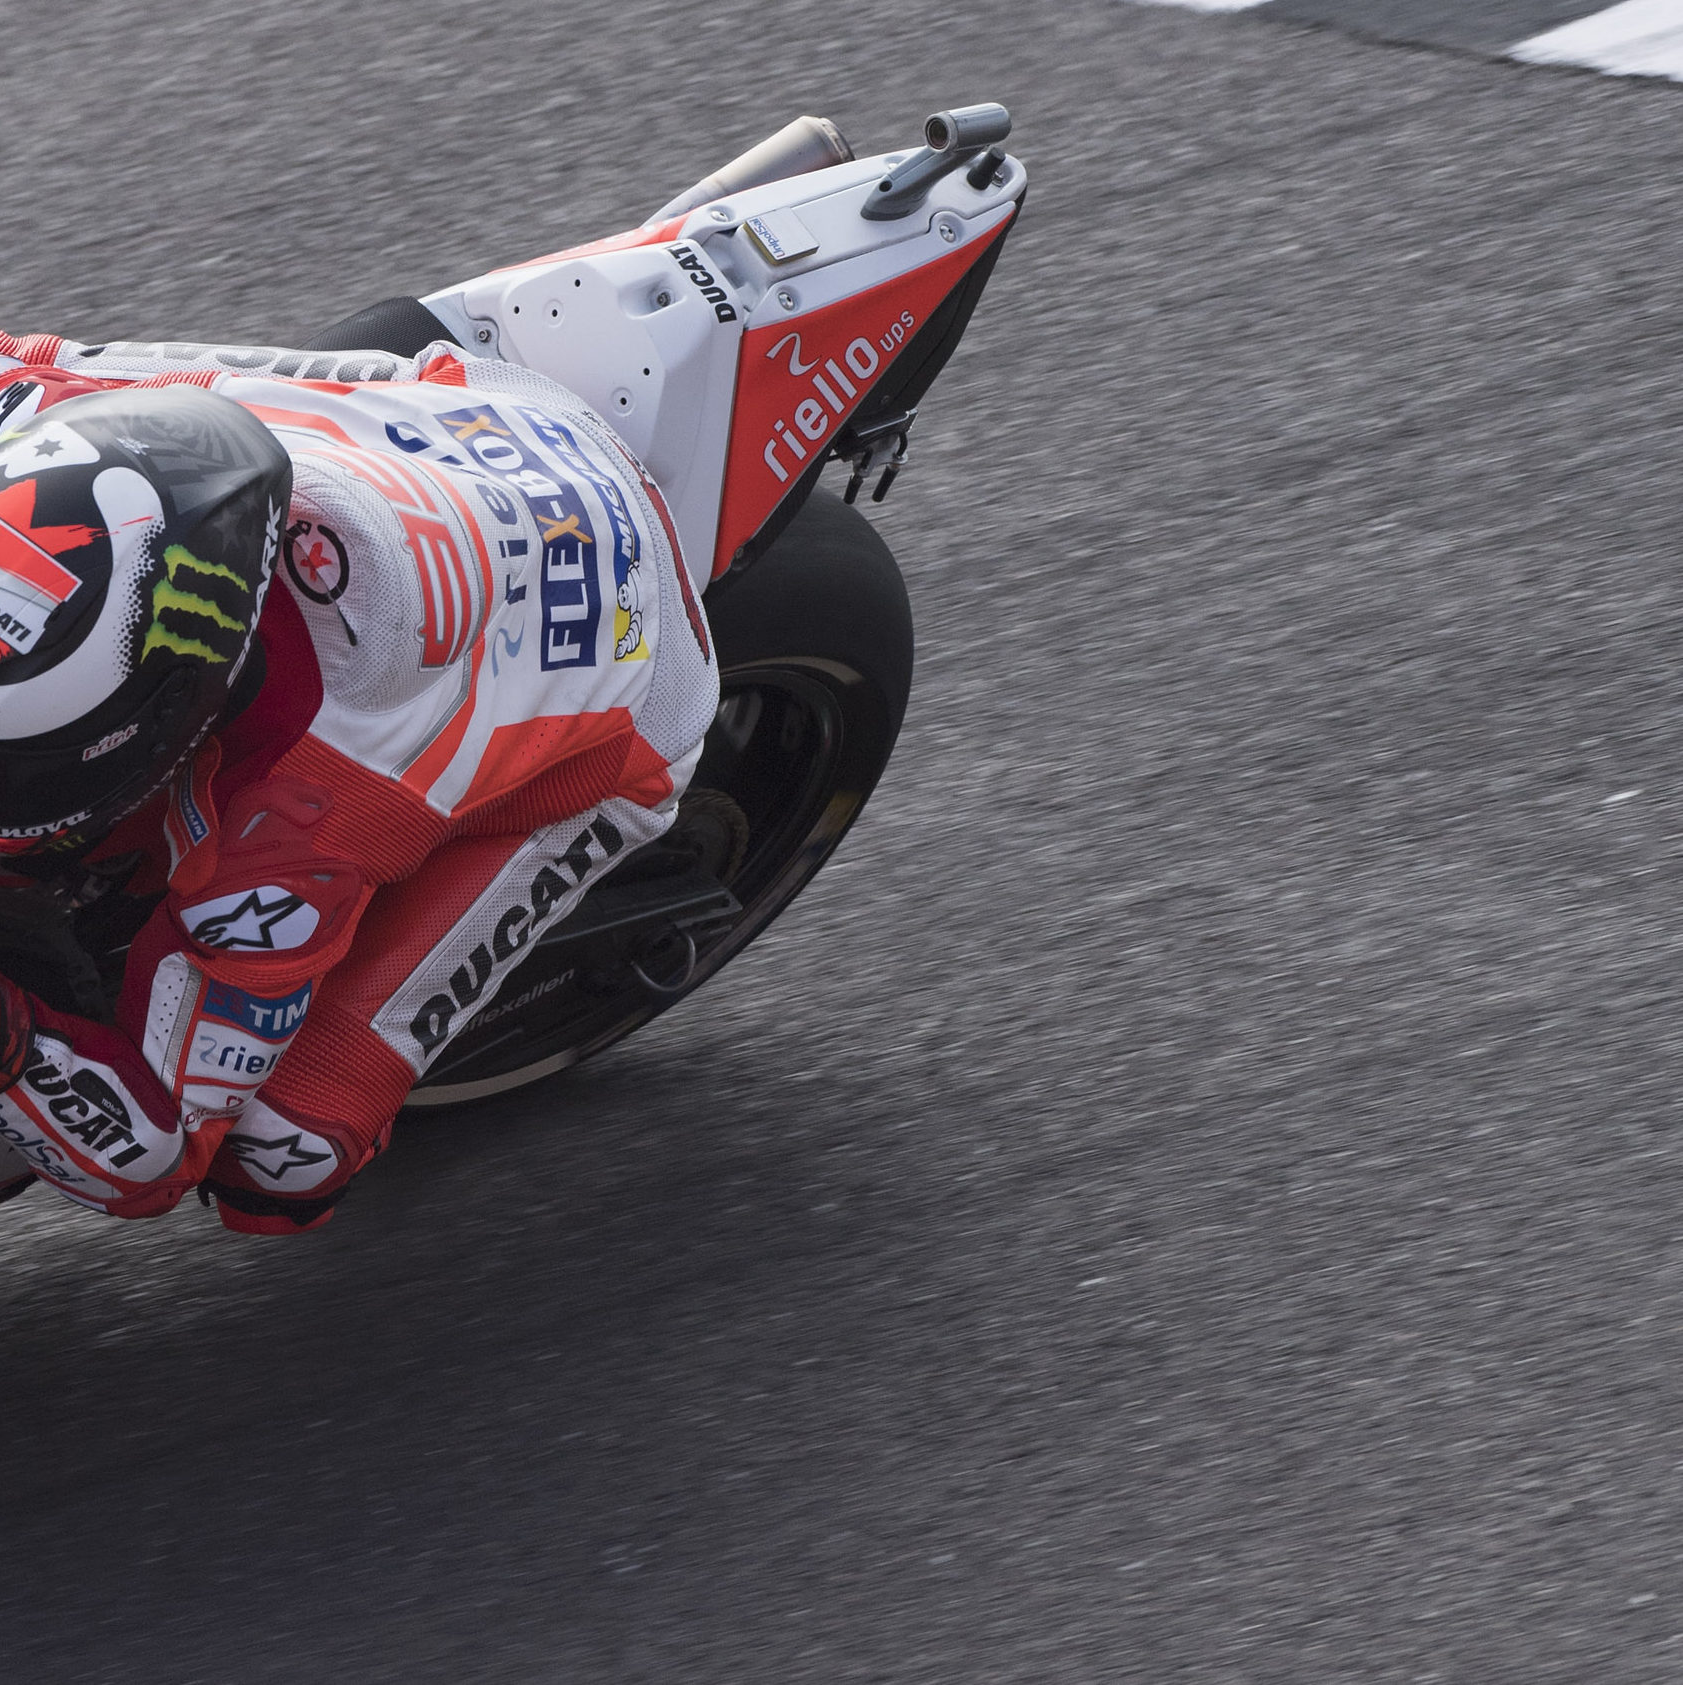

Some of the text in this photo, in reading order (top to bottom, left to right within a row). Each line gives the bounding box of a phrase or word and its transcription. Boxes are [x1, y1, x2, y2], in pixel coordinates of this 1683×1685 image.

[763, 309, 915, 483] riello ups
[443, 415, 596, 663] FLEX-BOX
[249, 990, 311, 1032] TIM
[410, 813, 624, 1060] DUCATI
